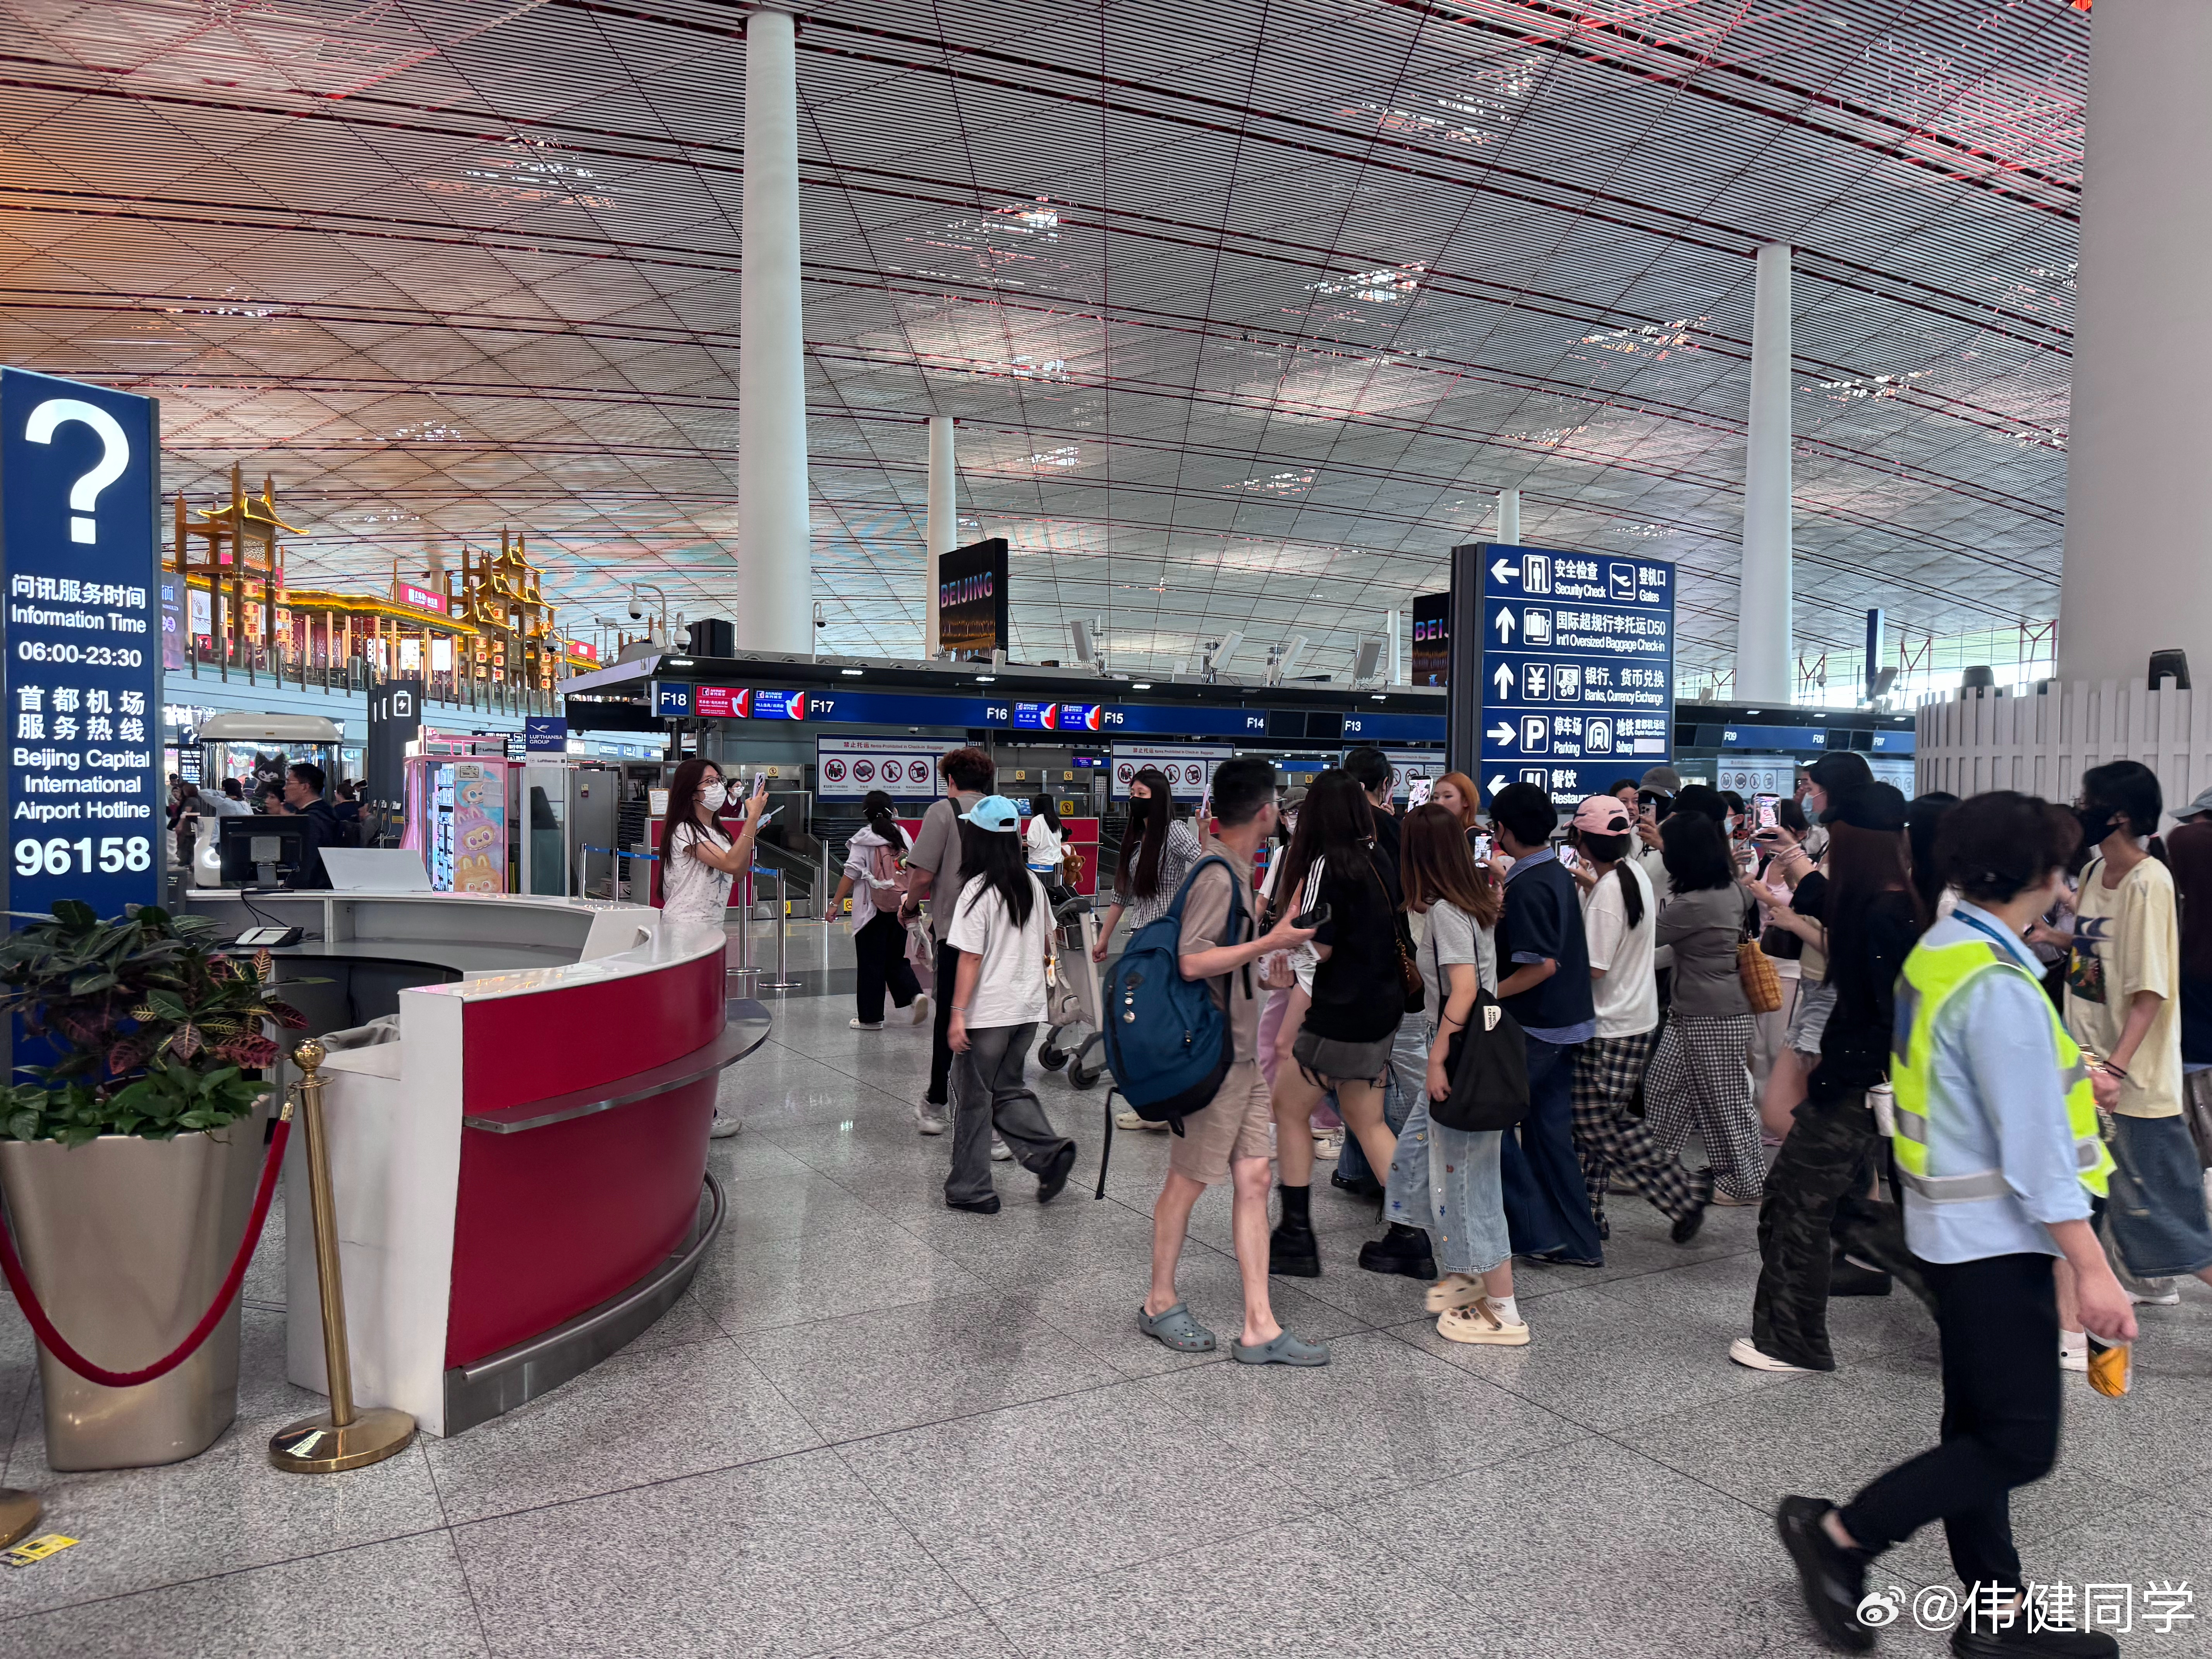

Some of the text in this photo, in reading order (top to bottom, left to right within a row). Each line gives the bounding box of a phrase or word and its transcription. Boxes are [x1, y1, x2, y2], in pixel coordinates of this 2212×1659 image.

[1555, 558, 1598, 580] 安全检查
[1639, 567, 1666, 587] 登机口
[12, 574, 146, 609] 问讯服务时间
[941, 571, 993, 608] BEIJING
[1555, 582, 1606, 599] Security Check
[1639, 589, 1659, 603] Gates
[12, 604, 104, 630] Information
[108, 613, 146, 633] Time
[1570, 634, 1605, 648] Oversized
[1606, 637, 1637, 652] Baggage
[1637, 639, 1665, 652] Check-in
[19, 641, 142, 667] 06:00-23:30
[17, 685, 145, 715] 首都机场
[661, 692, 687, 706] F18
[811, 700, 834, 713] F17
[1585, 689, 1664, 706] Banks, Currency Exchange
[987, 708, 1007, 720] F16
[1104, 712, 1123, 724] F15
[1247, 717, 1264, 728] F14
[17, 714, 144, 742] 服务热线
[1345, 720, 1361, 732] F13
[1554, 716, 1582, 736] 停车场
[1616, 718, 1634, 736] 地铁
[1724, 731, 1737, 741] F09
[1812, 734, 1824, 744] F08
[1873, 737, 1885, 746] F07
[1554, 741, 1580, 757] Parking
[14, 747, 150, 771] Beijing Capital
[25, 775, 141, 793] International
[1551, 769, 1577, 788] 餐饮
[1551, 792, 1597, 804] Restaur
[14, 801, 150, 823] Airport Hotline
[15, 836, 151, 876] 96158
